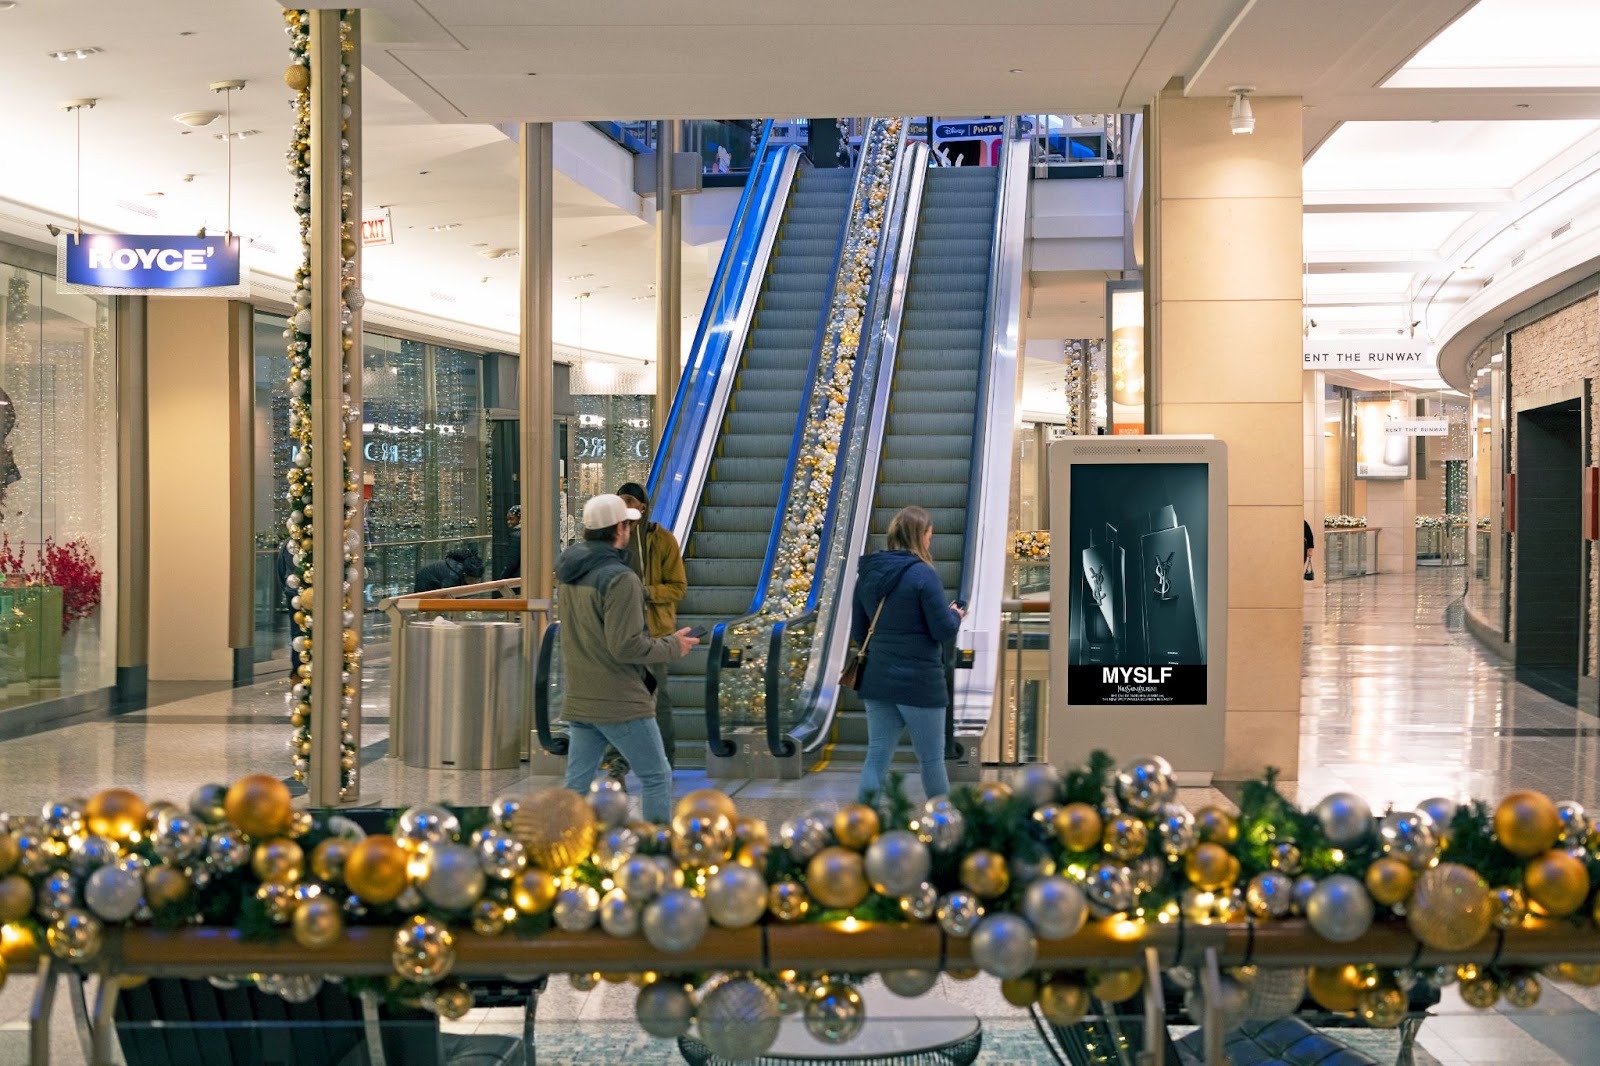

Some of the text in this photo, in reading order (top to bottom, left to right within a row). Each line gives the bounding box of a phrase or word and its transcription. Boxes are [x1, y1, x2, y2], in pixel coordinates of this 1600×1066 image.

[943, 126, 965, 135] Disney
[973, 124, 997, 134] PHOTO
[361, 219, 385, 239] EXIT
[1304, 352, 1422, 362] ENT THE RUNWAY
[1102, 666, 1173, 684] MYSLF
